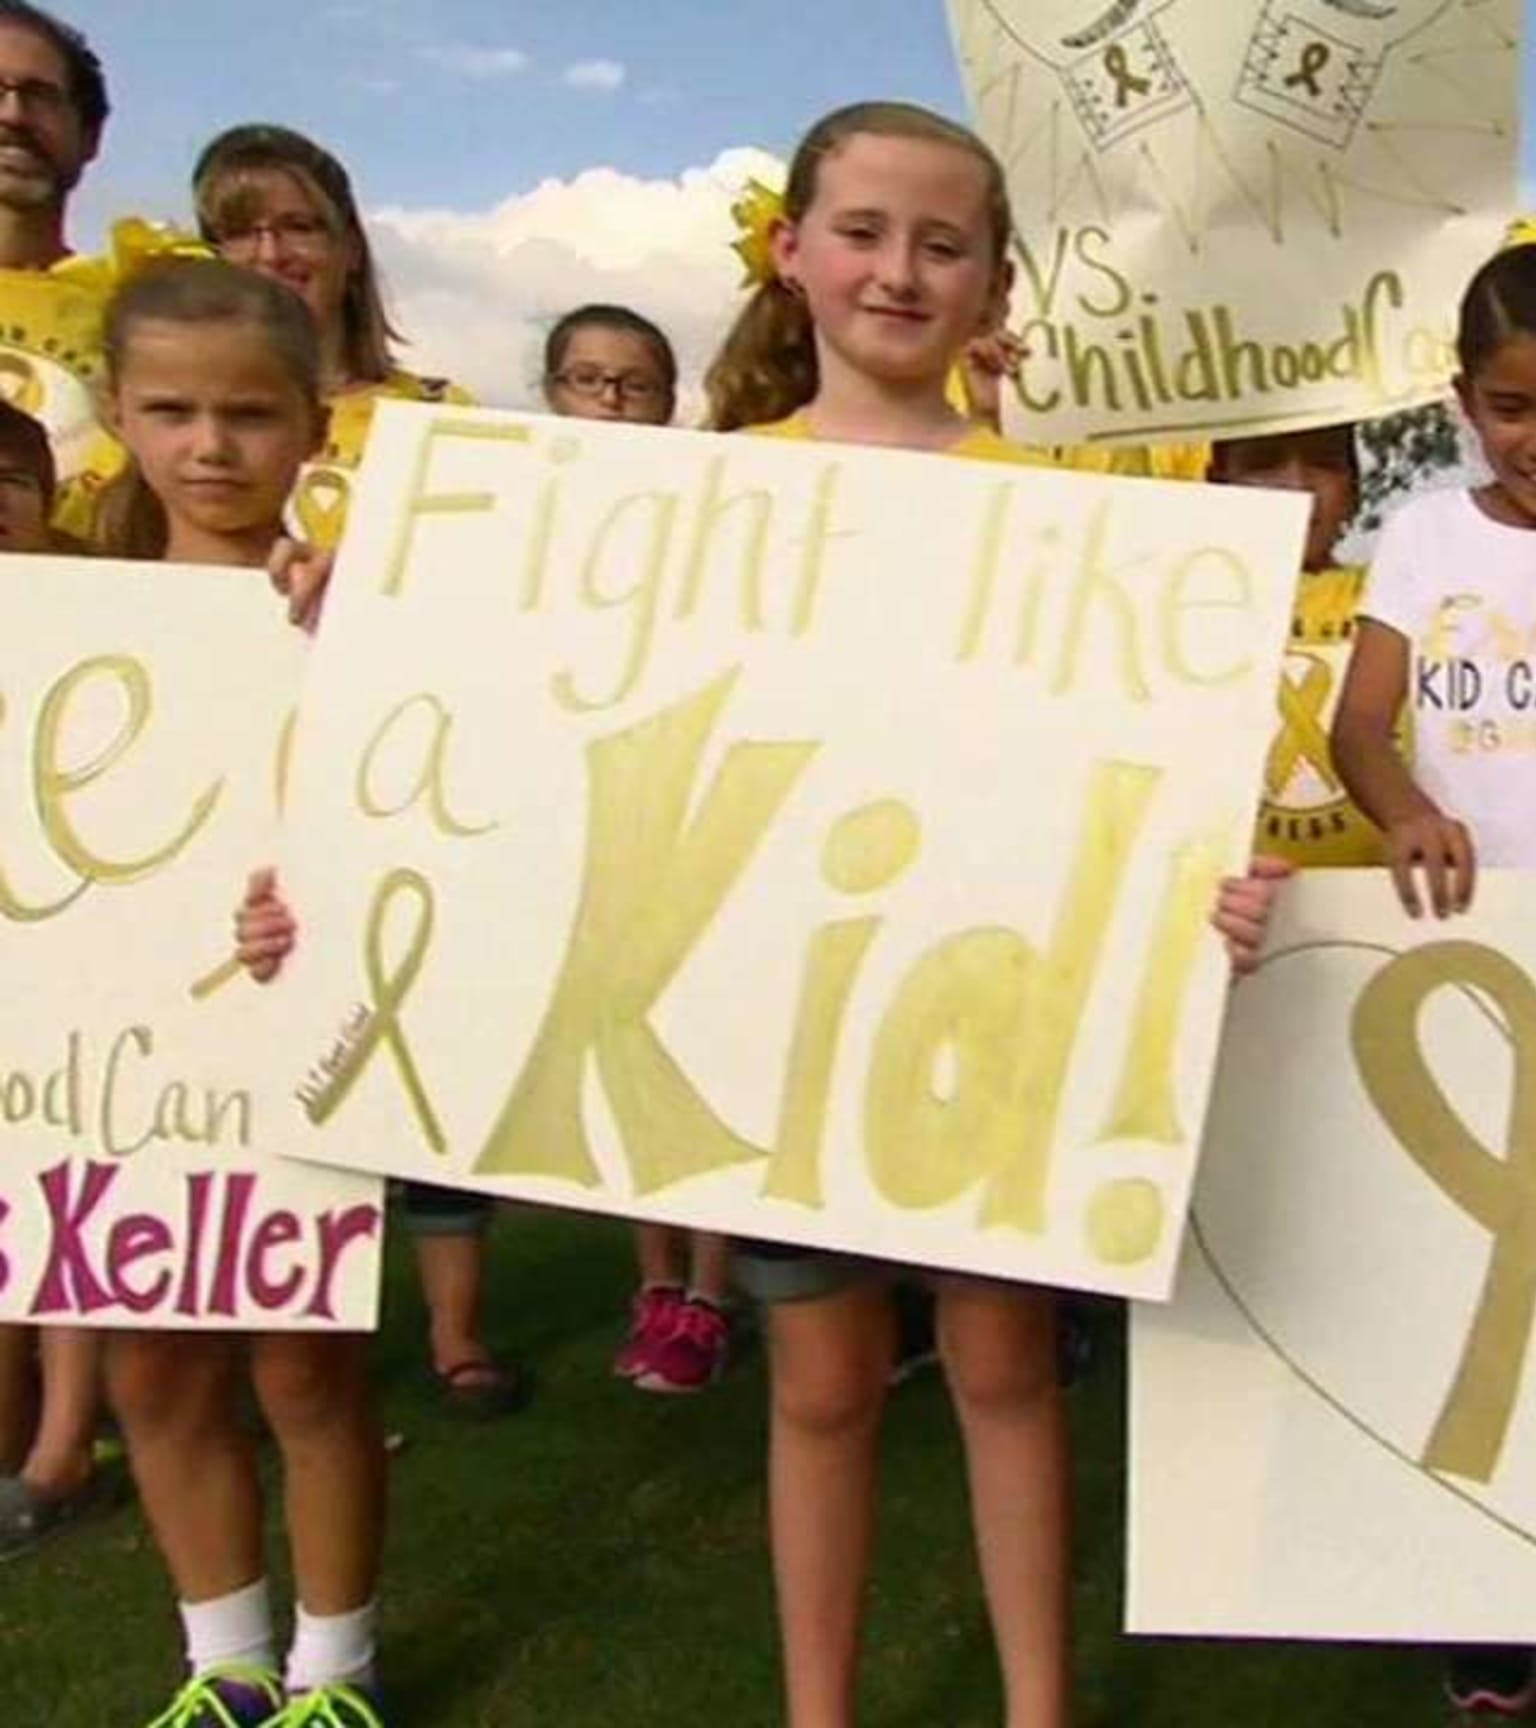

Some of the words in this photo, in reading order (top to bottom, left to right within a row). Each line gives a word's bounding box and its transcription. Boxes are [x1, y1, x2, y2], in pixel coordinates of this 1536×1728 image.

[381, 418, 864, 715] Fight
[955, 481, 1260, 706] like
[1416, 656, 1482, 711] KID
[356, 692, 501, 838] a
[472, 662, 1224, 1266] Kid!
[29, 1157, 380, 1321] Keller
